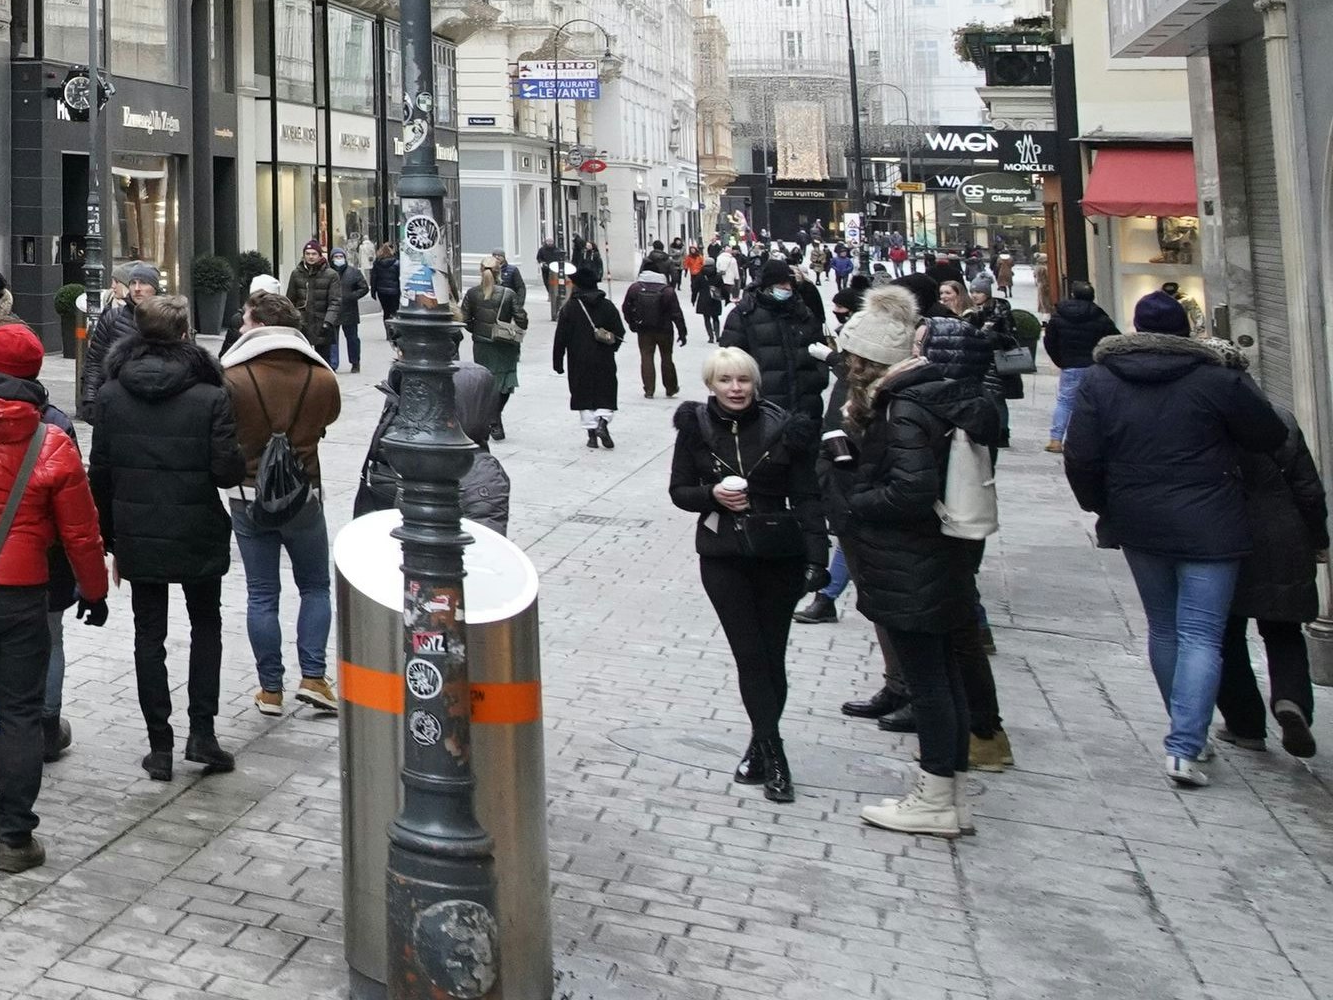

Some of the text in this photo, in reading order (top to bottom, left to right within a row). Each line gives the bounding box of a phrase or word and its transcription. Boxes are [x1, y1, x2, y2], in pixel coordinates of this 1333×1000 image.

[547, 62, 595, 70] TEMPO
[538, 80, 595, 88] RESTAURANT
[539, 88, 596, 98] LEVANTE
[1003, 163, 1055, 172] MONCLER
[795, 190, 825, 198] VUITTON
[962, 184, 984, 197] GS
[986, 187, 1031, 195] International
